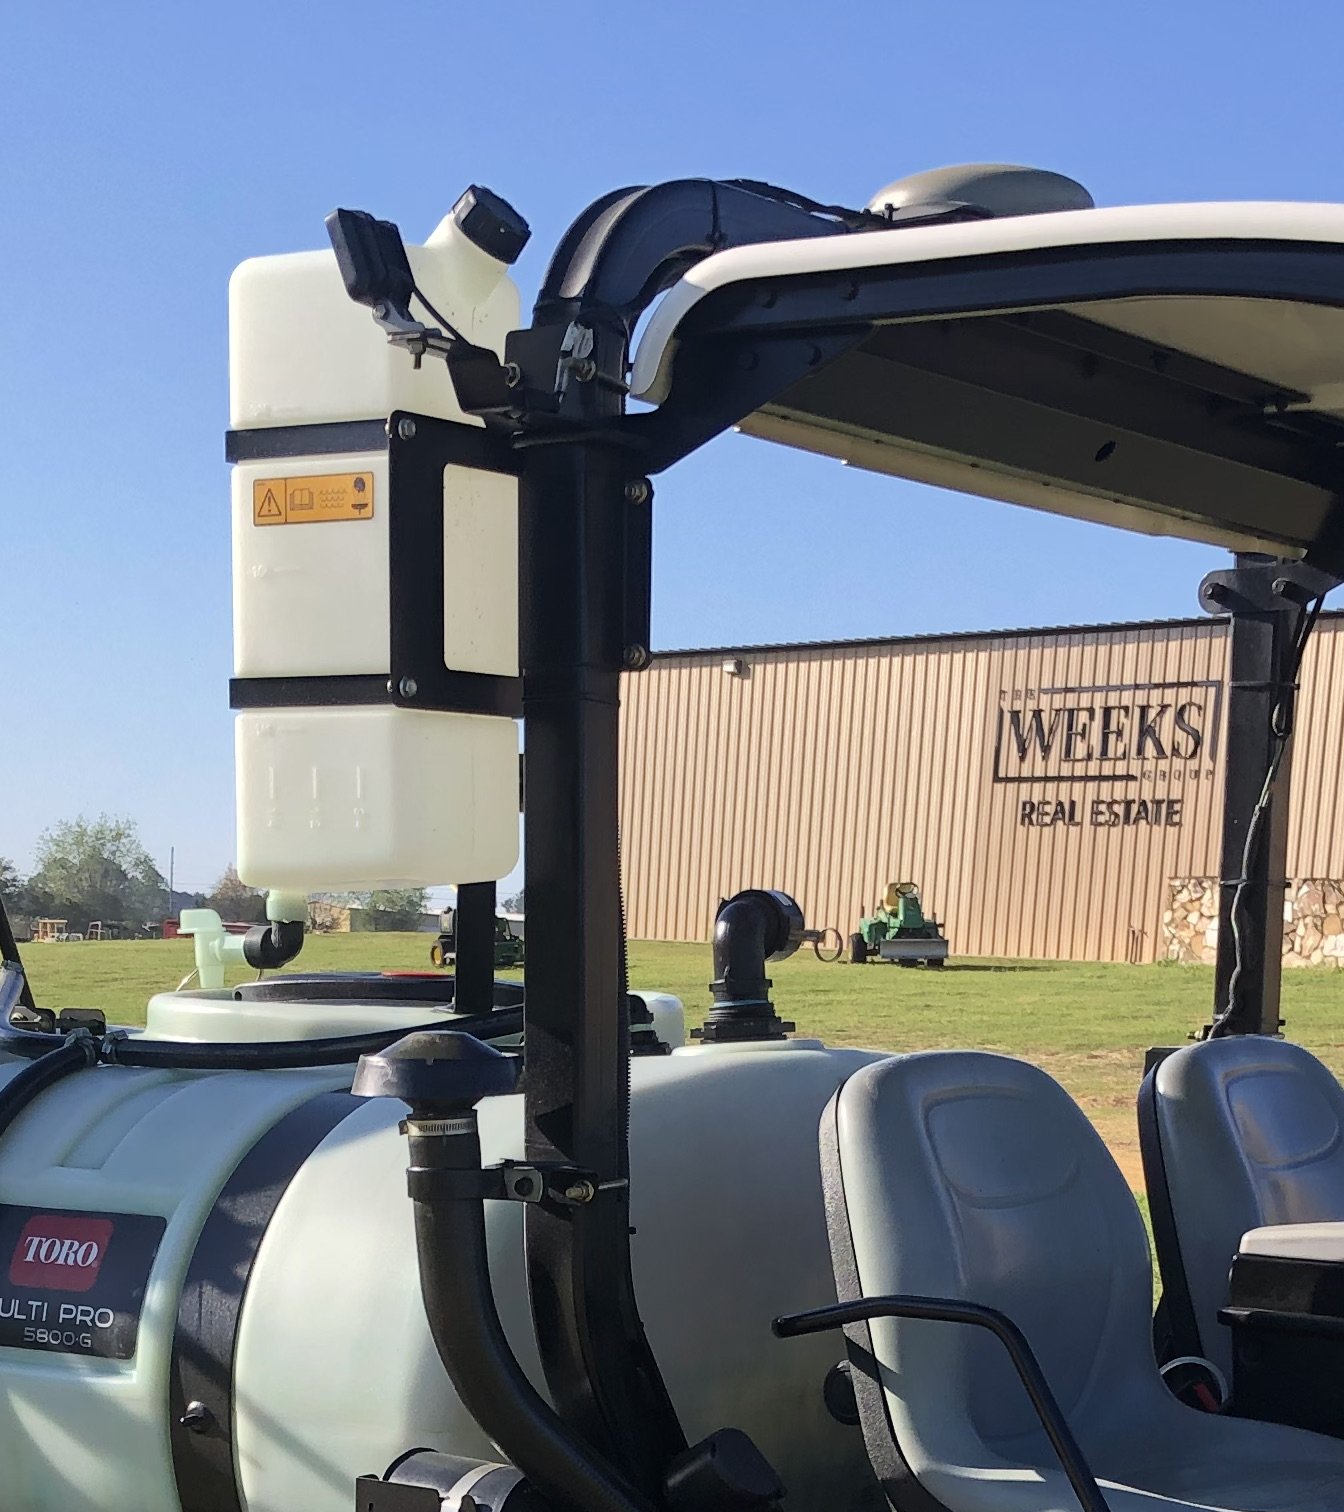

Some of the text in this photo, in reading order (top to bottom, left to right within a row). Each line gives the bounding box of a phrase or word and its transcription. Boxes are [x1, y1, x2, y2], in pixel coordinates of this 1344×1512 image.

[1007, 701, 1203, 763] WEEKS
[1020, 799, 1184, 828] REAL ESTATE
[23, 1236, 99, 1268] TORO
[58, 1303, 114, 1329] PRO
